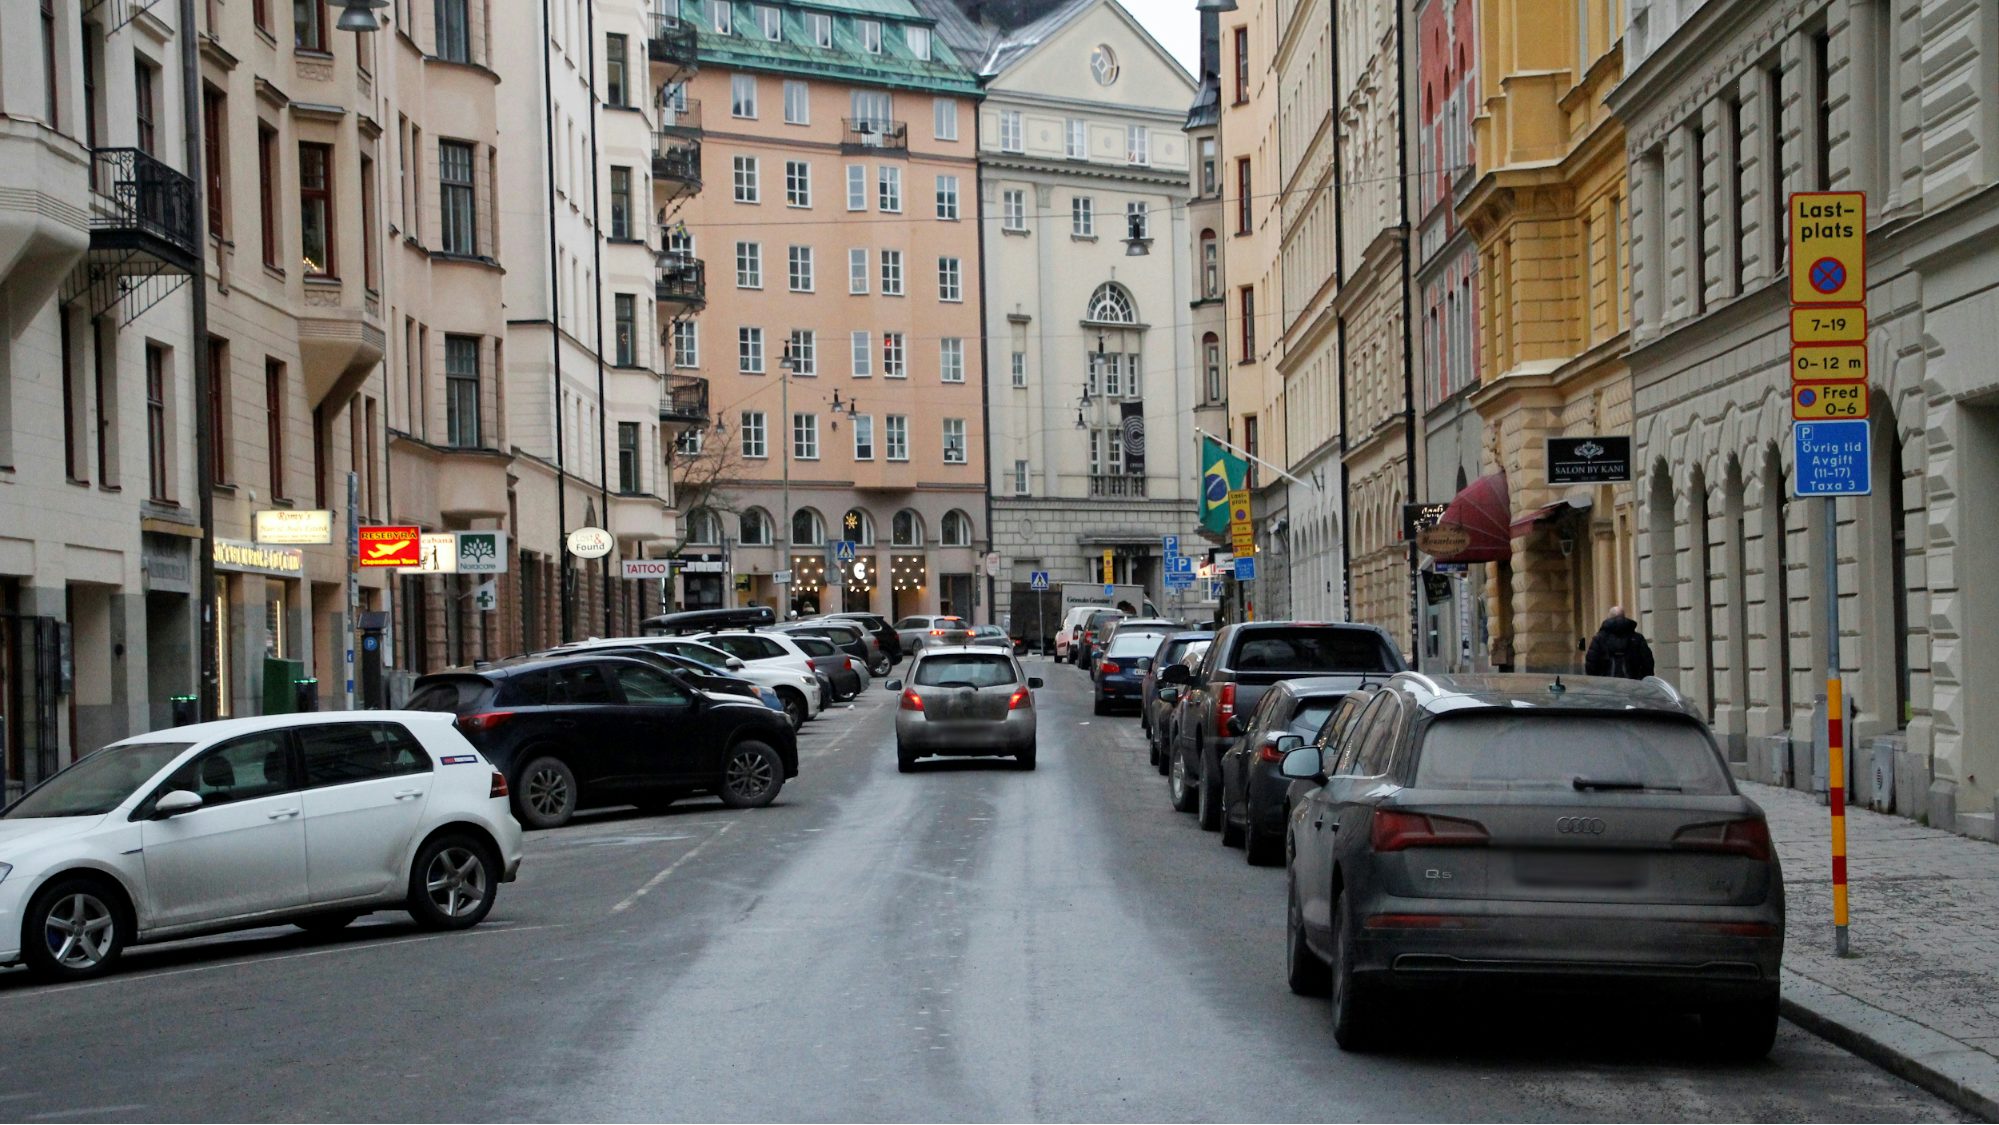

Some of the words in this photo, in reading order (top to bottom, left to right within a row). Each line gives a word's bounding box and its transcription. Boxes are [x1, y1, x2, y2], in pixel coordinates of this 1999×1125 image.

[1800, 202, 1854, 218] Last-
[1801, 222, 1853, 242] plats
[1811, 318, 1846, 331] 7-19
[1798, 357, 1839, 369] 0-12
[1848, 359, 1861, 368] m
[1823, 386, 1858, 399] Fred
[1825, 402, 1856, 415] 0-6
[1802, 427, 1811, 439] P
[1802, 441, 1838, 454] Övrig
[1844, 441, 1862, 452] tid
[1812, 455, 1852, 467] Avgift
[1555, 466, 1585, 474] SALON
[1587, 465, 1599, 473] BY
[1601, 465, 1624, 473] KANI
[1814, 467, 1851, 479] (11-17)
[1810, 481, 1842, 491] Taxa
[1848, 480, 1855, 490] 3
[361, 528, 417, 540] RESEBYRÅ
[594, 533, 602, 544] &
[421, 536, 453, 545] cabana
[576, 543, 605, 551] Found
[460, 562, 496, 571] Noracare
[626, 563, 666, 574] TATTOO
[1178, 559, 1187, 571] P
[1425, 869, 1453, 879] Q5
